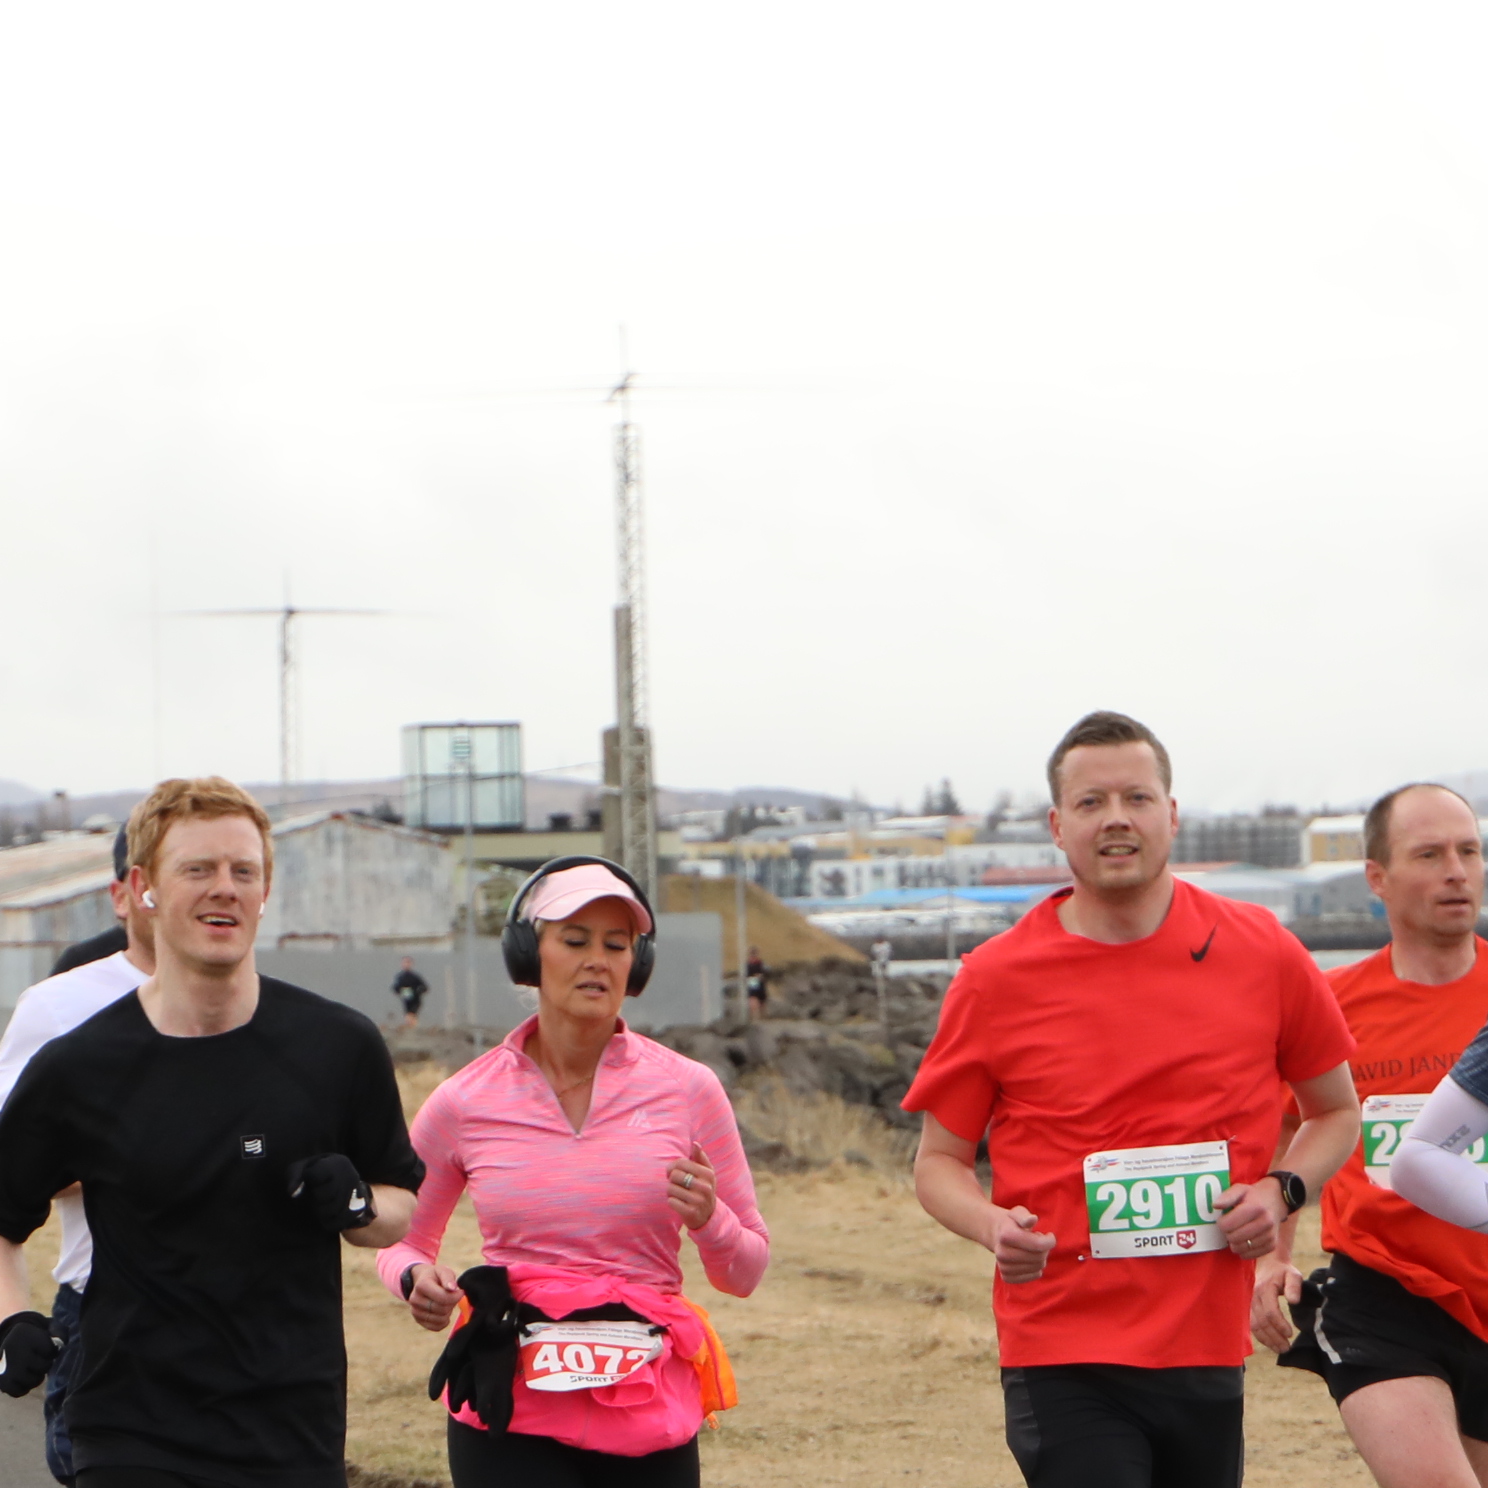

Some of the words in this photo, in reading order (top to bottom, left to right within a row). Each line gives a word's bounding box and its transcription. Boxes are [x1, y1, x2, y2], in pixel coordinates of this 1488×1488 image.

[1352, 1059, 1403, 1082] AVID
[1096, 1174, 1223, 1231] 2910
[1134, 1234, 1174, 1248] SPORT
[1177, 1231, 1196, 1247] 24
[570, 1375, 607, 1384] SPORT
